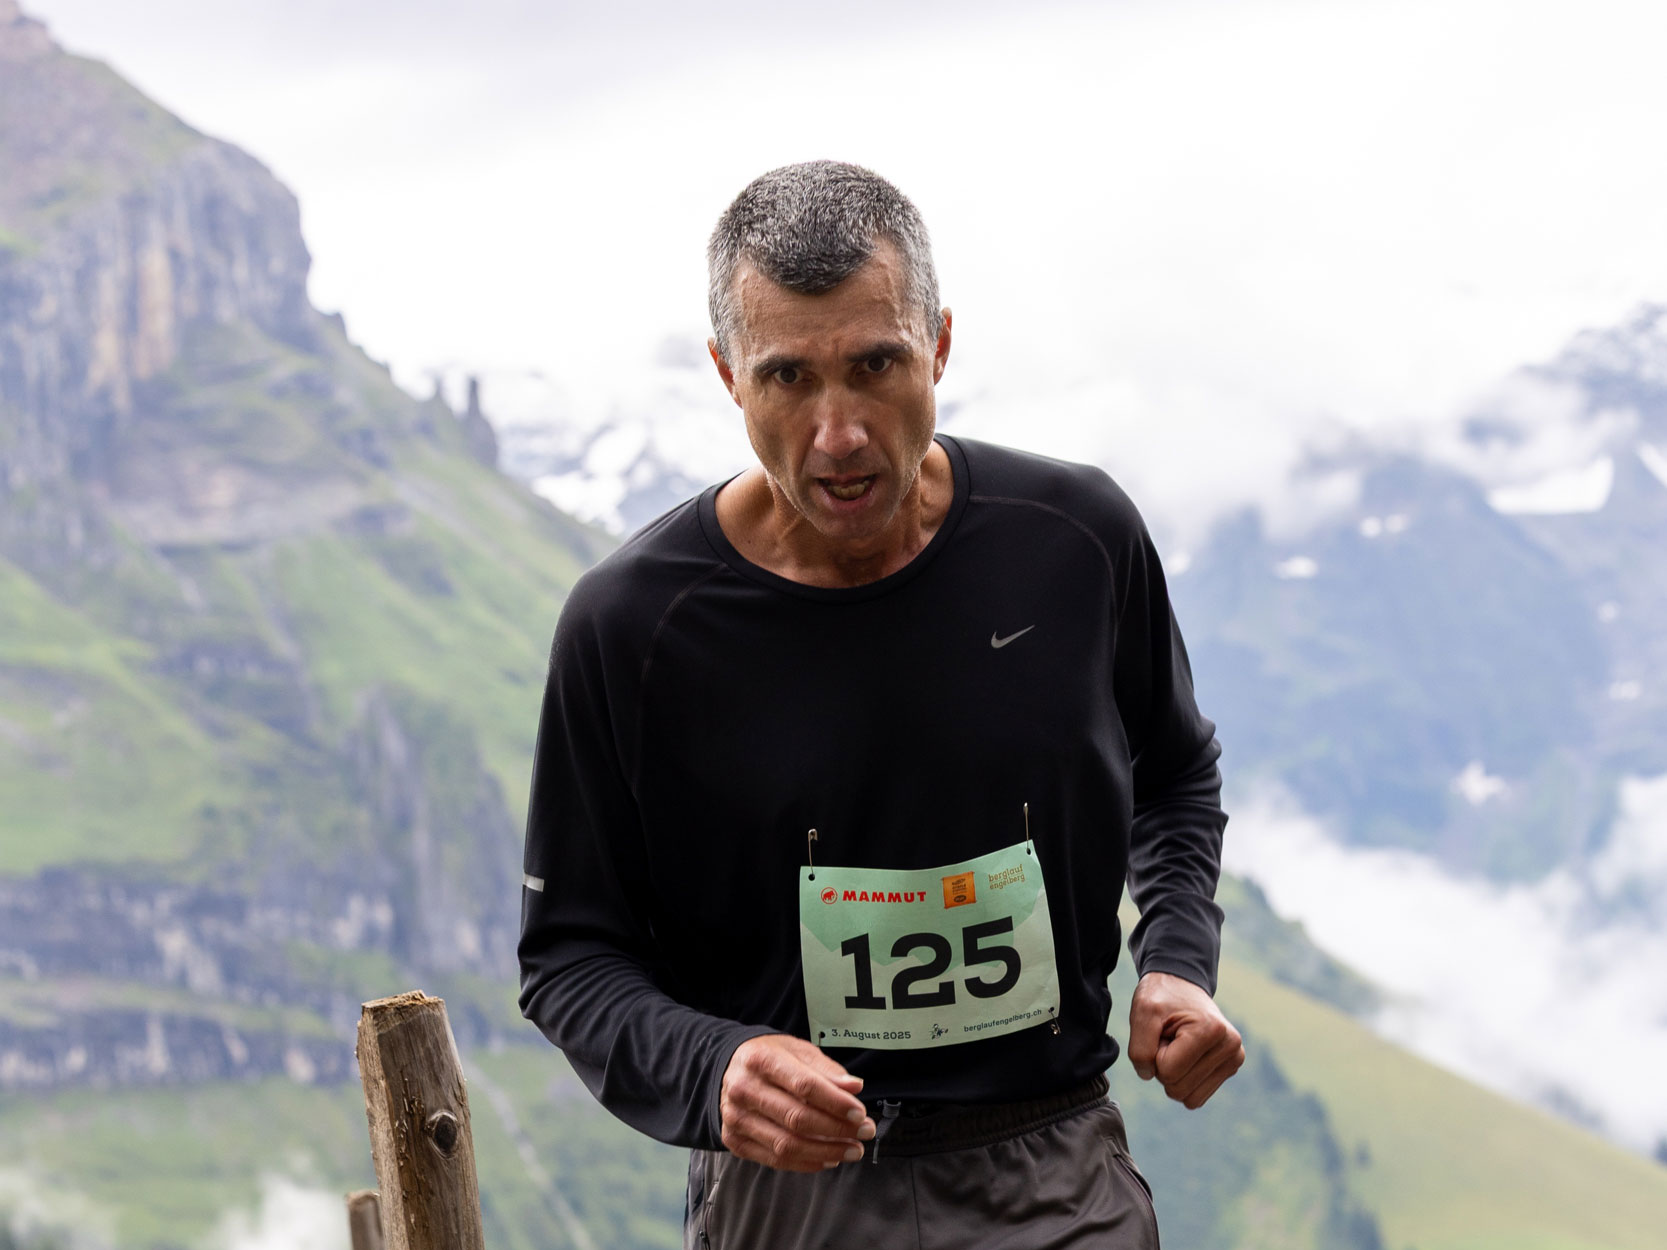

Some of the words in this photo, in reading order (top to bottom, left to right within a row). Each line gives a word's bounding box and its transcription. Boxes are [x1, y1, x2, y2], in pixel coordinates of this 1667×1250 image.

[988, 864, 1023, 882] berglauf
[989, 874, 1026, 890] engelberg
[842, 890, 927, 903] MAMMUT
[841, 915, 1021, 1010] 125
[963, 1008, 1042, 1032] berglaufengelberg.ch
[832, 1029, 841, 1037] 3.
[843, 1029, 881, 1040] August
[883, 1031, 911, 1039] 2025
